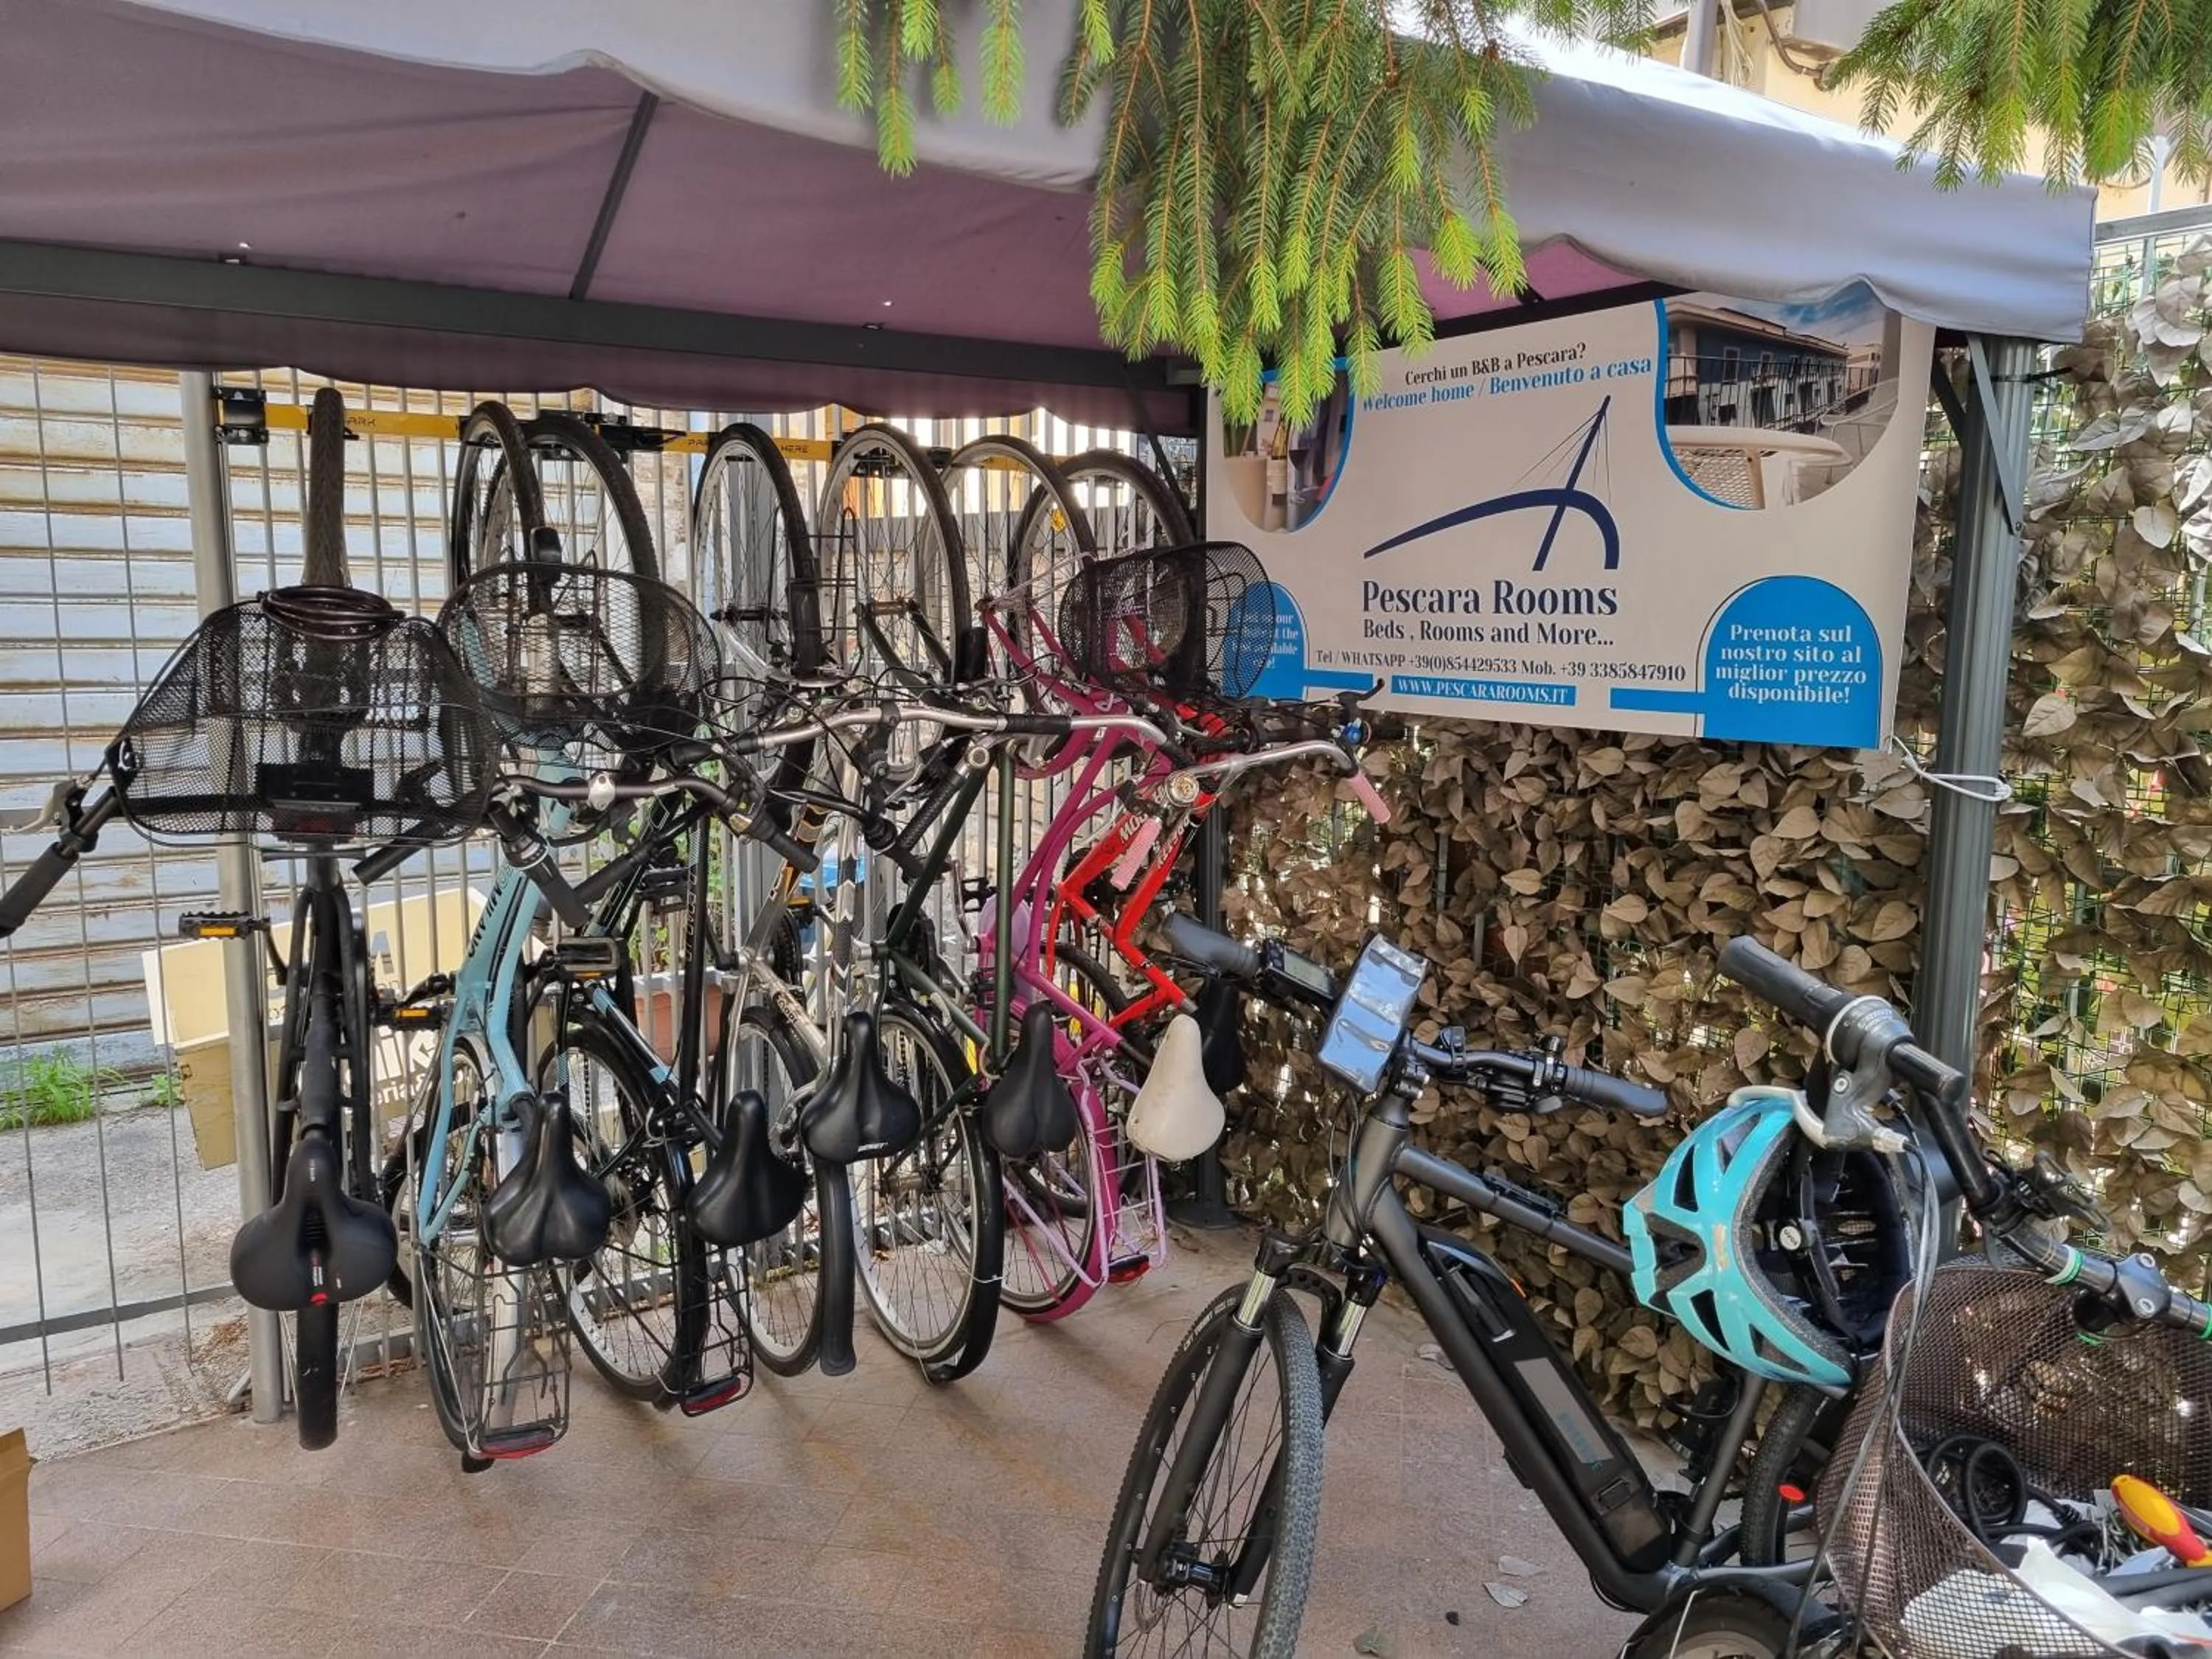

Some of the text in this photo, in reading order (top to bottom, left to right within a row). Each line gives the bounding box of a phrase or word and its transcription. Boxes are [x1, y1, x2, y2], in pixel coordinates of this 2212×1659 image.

[1405, 342, 1587, 386] Cerchi un B&B a Pescara?
[1430, 382, 1474, 403] home
[1489, 368, 1585, 394] Benvenuto
[1590, 366, 1601, 380] a
[1607, 357, 1652, 378] casa
[1363, 578, 1618, 616] Pescara Rooms
[1363, 619, 1405, 640] Beds
[1419, 619, 1484, 642] Rooms
[1490, 622, 1530, 644] and
[1537, 622, 1614, 646] More...
[1730, 625, 1851, 642] Prenota sul
[1317, 650, 1333, 664] Tel
[1341, 650, 1407, 668] WHATSAPP
[1409, 654, 1517, 674] +39(0)854429533
[1521, 660, 1557, 675] Mob.
[1560, 661, 1586, 677] +39
[1590, 661, 1686, 681] 3385847910
[1721, 645, 1862, 663] nostro sito al
[1715, 663, 1867, 686] miglior prezzo
[1398, 678, 1569, 703] WWW.PESCARAROOMS.IT
[1728, 681, 1851, 704] disponibile!
